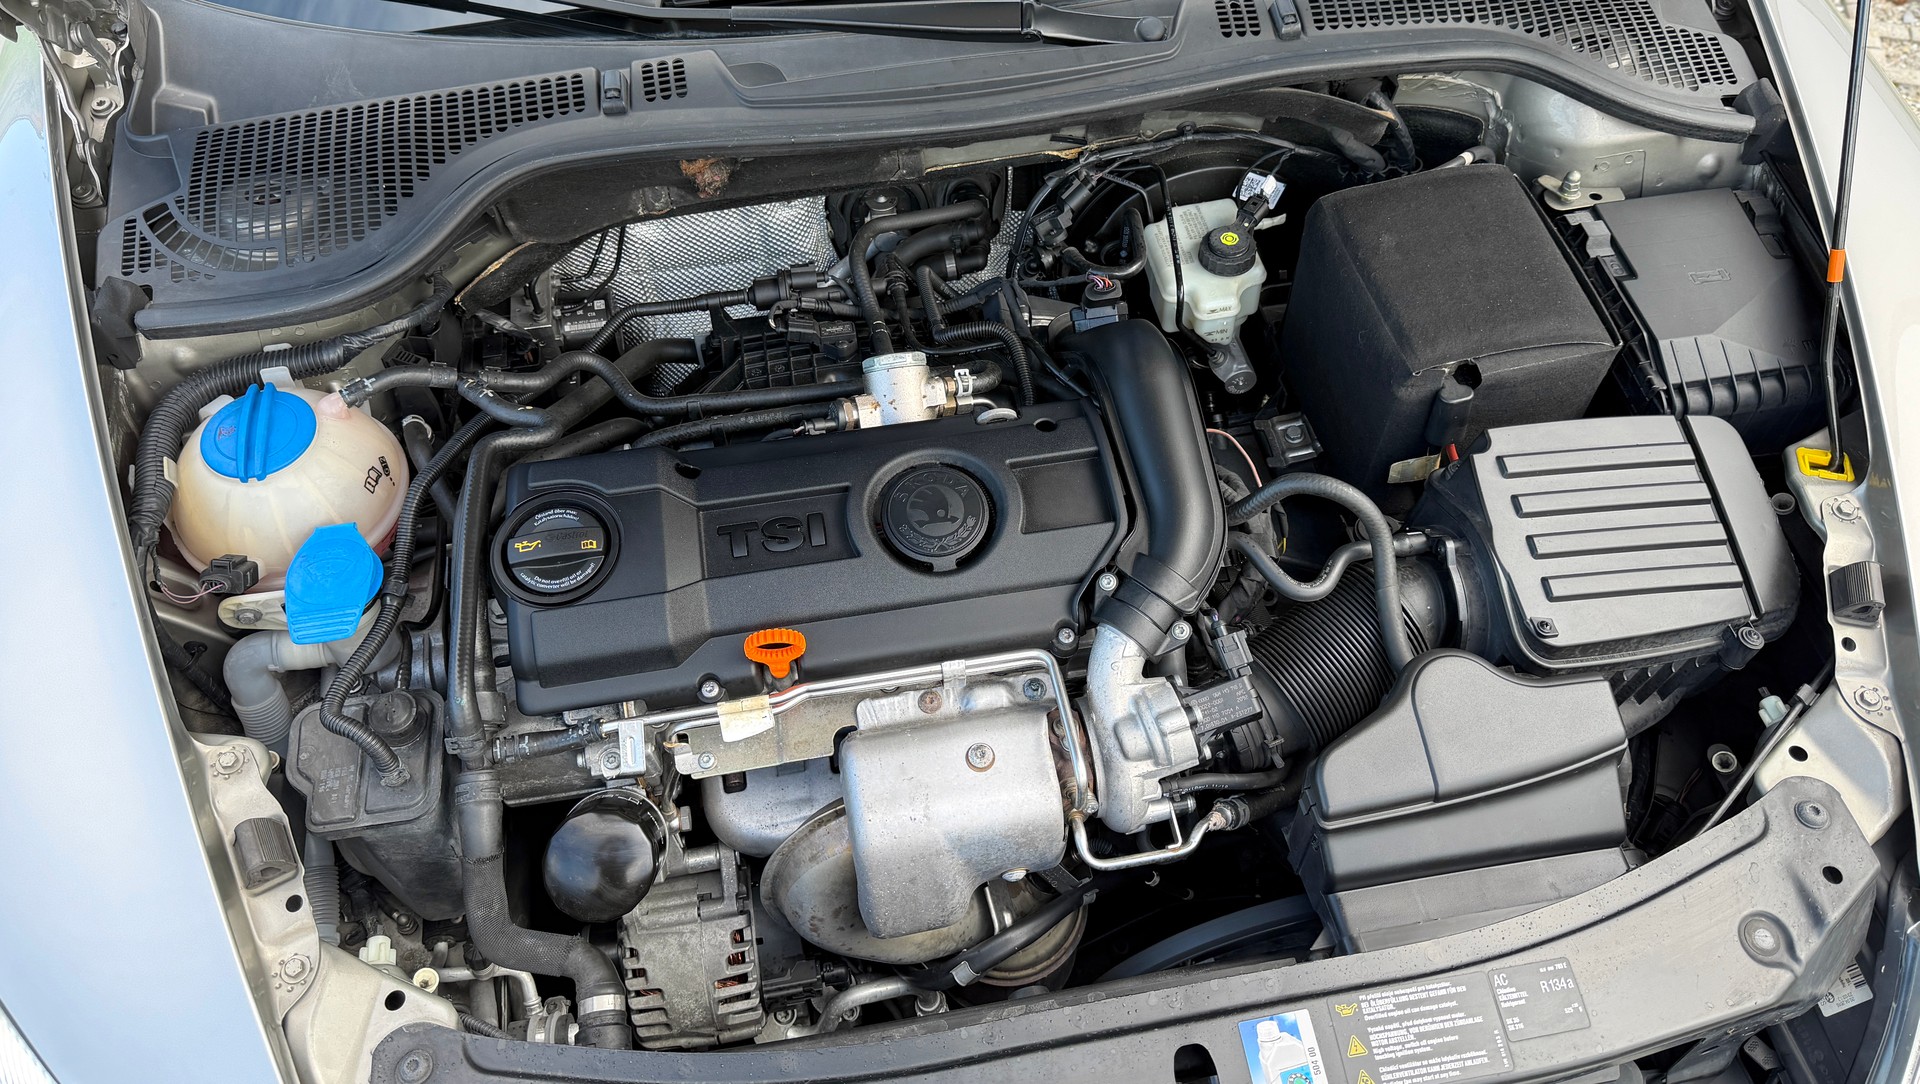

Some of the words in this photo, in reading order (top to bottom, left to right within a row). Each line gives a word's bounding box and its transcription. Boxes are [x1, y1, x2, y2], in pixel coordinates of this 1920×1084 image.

[717, 512, 827, 558] TSI
[1493, 973, 1508, 987] AC
[1307, 1046, 1317, 1058] 00
[1312, 1060, 1321, 1076] 504
